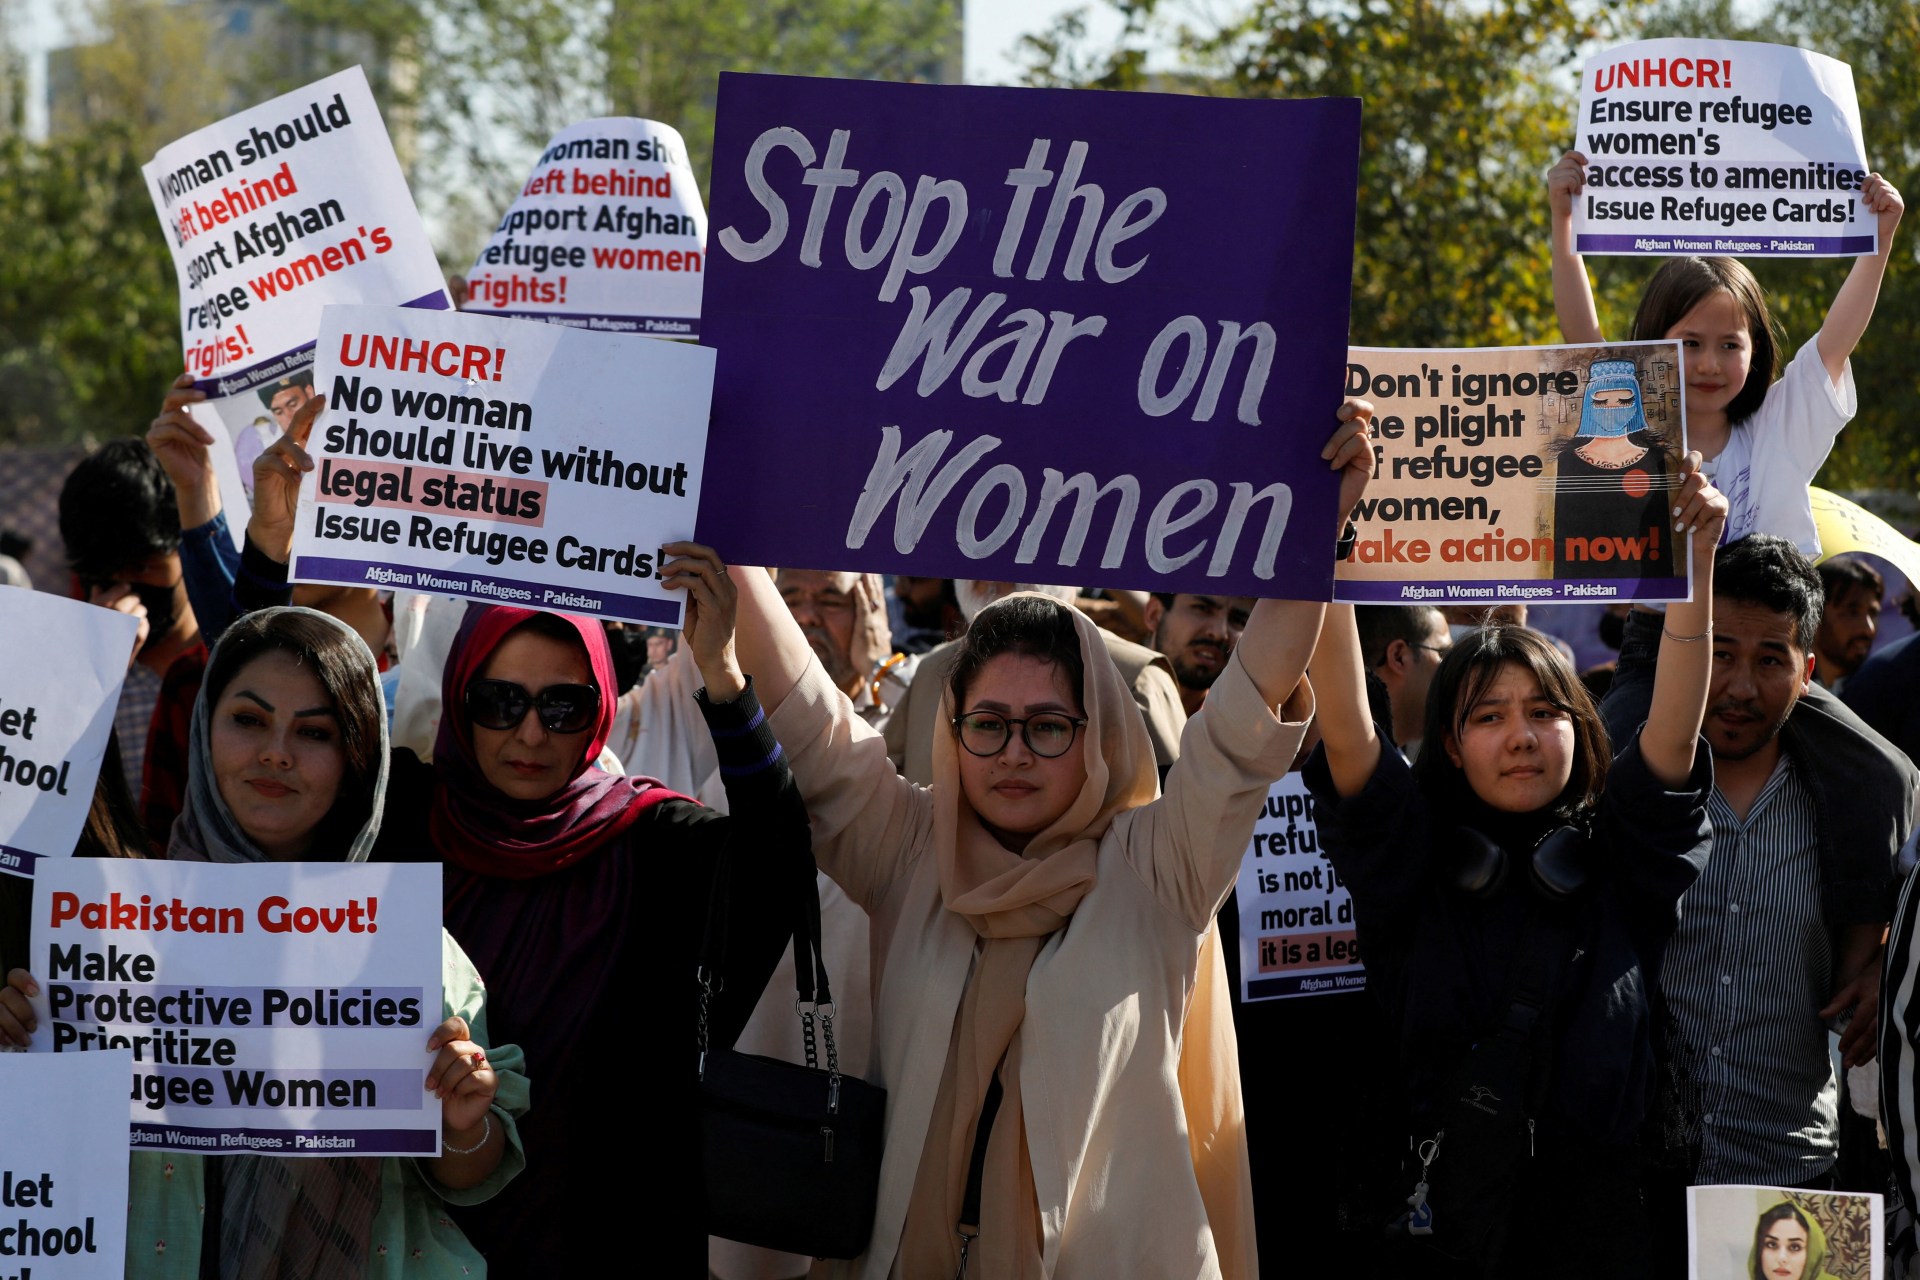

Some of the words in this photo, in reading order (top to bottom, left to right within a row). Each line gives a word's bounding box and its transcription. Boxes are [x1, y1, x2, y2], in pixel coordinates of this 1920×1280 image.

[1594, 58, 1732, 92] UNHCR!
[236, 93, 351, 166] should
[1590, 97, 1692, 124] Ensure
[1699, 96, 1812, 130] refugee
[1587, 127, 1720, 155] women's
[523, 169, 566, 197] left
[572, 168, 671, 198] behind
[1587, 165, 1684, 188] access
[1690, 162, 1718, 188] to
[1725, 162, 1866, 191] amenities
[193, 162, 298, 232] behind
[718, 126, 968, 302] Stop
[993, 138, 1167, 283] the
[1587, 196, 1654, 220] Issue
[1661, 196, 1767, 227] Refugee
[1772, 198, 1855, 223] Cards!
[233, 198, 346, 265] Afghan
[593, 204, 696, 240] Afghan
[476, 238, 586, 272] refugee
[1634, 239, 1671, 251] Afghan
[1673, 239, 1712, 250] Women
[1715, 240, 1761, 251] Refugees
[1770, 240, 1815, 251] Pakistan
[248, 226, 393, 302] women's
[468, 274, 567, 308] rights!
[645, 320, 691, 333] Pakistan
[248, 361, 286, 383] Women
[339, 334, 506, 382] UNHCR!
[876, 286, 1107, 405] War
[1138, 315, 1277, 426] on
[1345, 363, 1444, 398] Don't
[1451, 365, 1578, 402] ignore
[330, 375, 382, 414] No
[392, 390, 532, 431] woman
[1414, 405, 1526, 445] plight
[323, 418, 456, 466] should
[462, 432, 532, 474] live
[542, 445, 688, 497] without
[1392, 445, 1543, 487] refugee
[319, 459, 413, 507] legal
[422, 473, 542, 519] status
[845, 425, 1293, 579] Women
[1349, 495, 1501, 526] women,
[315, 506, 400, 544] Issue
[409, 515, 548, 566] Refugee
[556, 535, 666, 580] Cards!
[1439, 527, 1554, 563] action
[1565, 526, 1661, 562] now!
[365, 566, 413, 585] Afghan
[416, 573, 468, 592] Women
[470, 580, 532, 601] Refugees
[543, 590, 602, 610] Pakistan
[1401, 585, 1444, 600] Afghan
[1447, 585, 1494, 598] Women
[1497, 584, 1553, 599] Refugees
[1564, 584, 1617, 597] Pakistan
[1253, 823, 1328, 859] refu
[1257, 868, 1279, 894] is
[1284, 866, 1323, 892] not
[50, 891, 244, 934] Pakistan
[257, 895, 378, 934] Govt!
[1261, 900, 1332, 930] moral
[1337, 899, 1355, 924] d
[48, 943, 156, 982] Make
[1261, 941, 1277, 967] it
[1282, 939, 1301, 965] is
[1306, 942, 1321, 964] a
[1300, 977, 1333, 992] Afghan
[49, 984, 252, 1027] Protective
[262, 988, 421, 1027] Policies
[222, 1070, 376, 1107] Women
[165, 1131, 217, 1147] Women
[220, 1133, 283, 1149] Refugees
[295, 1135, 356, 1149] Pakistan
[2, 1171, 54, 1208] let
